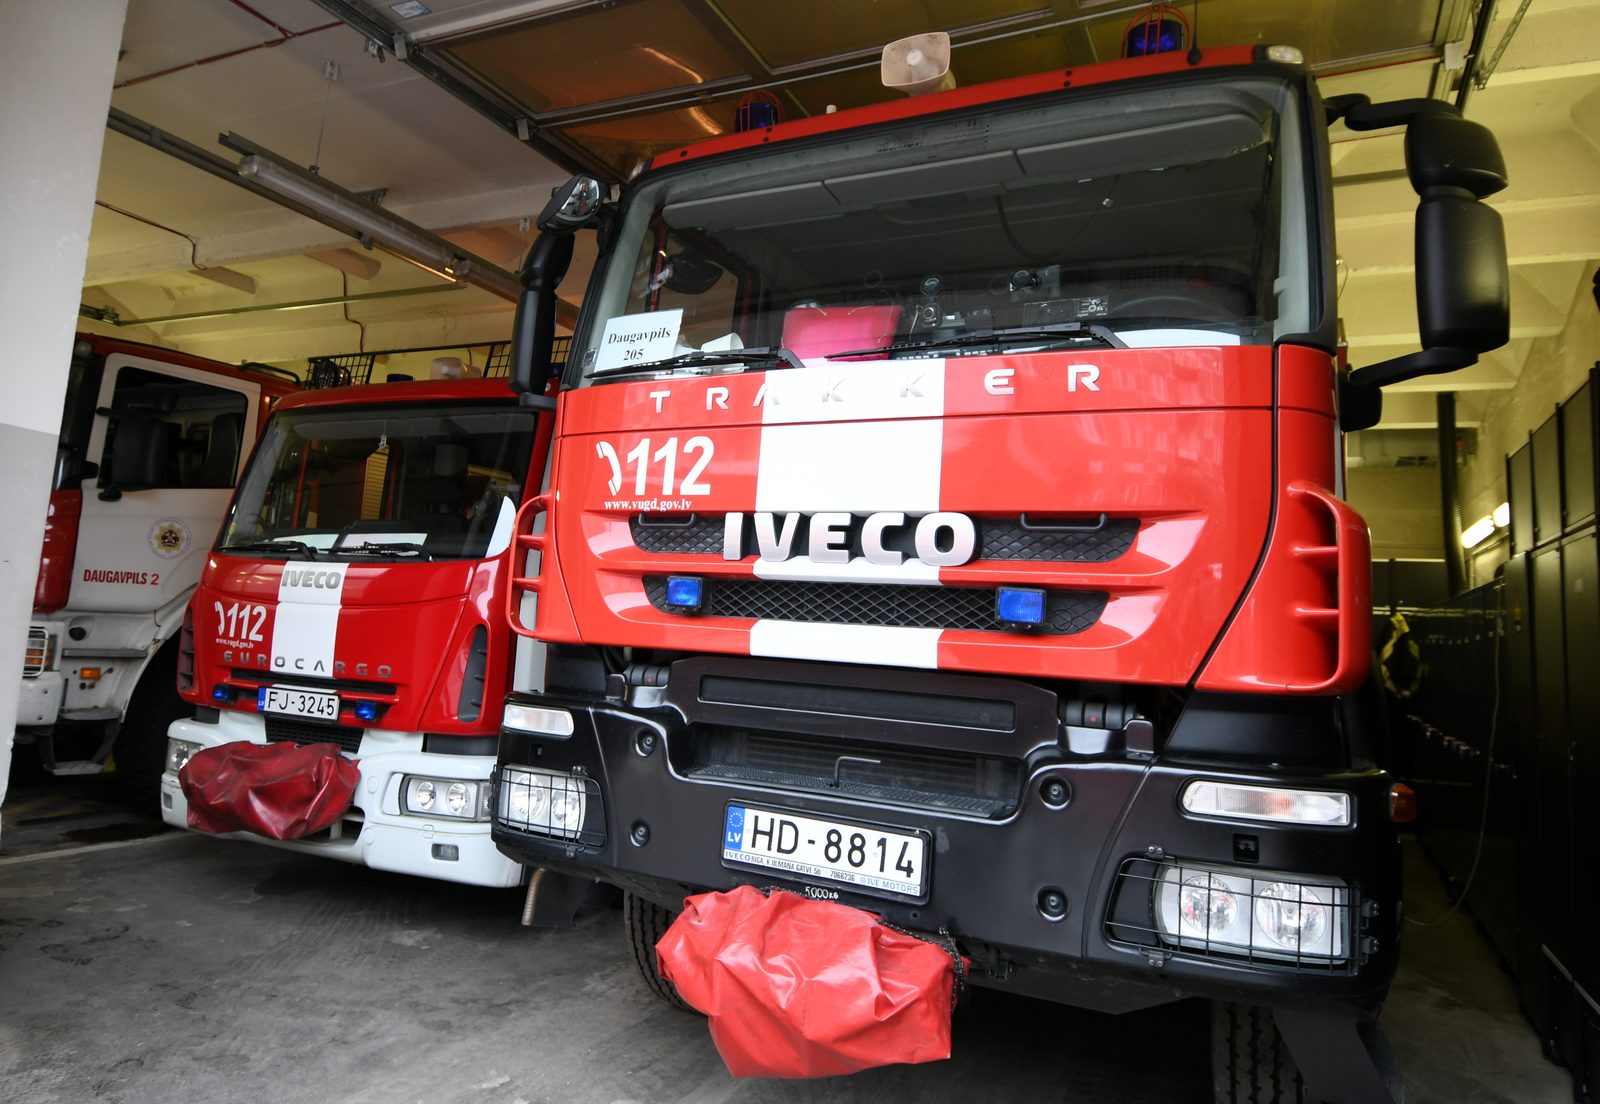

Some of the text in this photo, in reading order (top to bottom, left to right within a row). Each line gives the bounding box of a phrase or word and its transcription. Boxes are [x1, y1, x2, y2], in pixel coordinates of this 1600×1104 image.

[608, 327, 671, 345] Daugavpils
[623, 348, 644, 361] 205
[649, 364, 1101, 413] TRAKKER
[627, 435, 715, 496] 112
[604, 498, 692, 512] www.vugd.gov.lv
[722, 511, 978, 567] IVECO
[83, 569, 160, 586] DAUGAVPILS 2
[281, 569, 342, 590] IVECO
[227, 602, 267, 642] 112
[223, 650, 392, 679] EUROCARGO
[267, 691, 336, 717] FJ-3245
[727, 832, 742, 844] LV
[751, 815, 915, 879] HD-8814
[725, 850, 751, 862] IVECO
[867, 877, 881, 887] IVE
[882, 880, 919, 895] MOTORS
